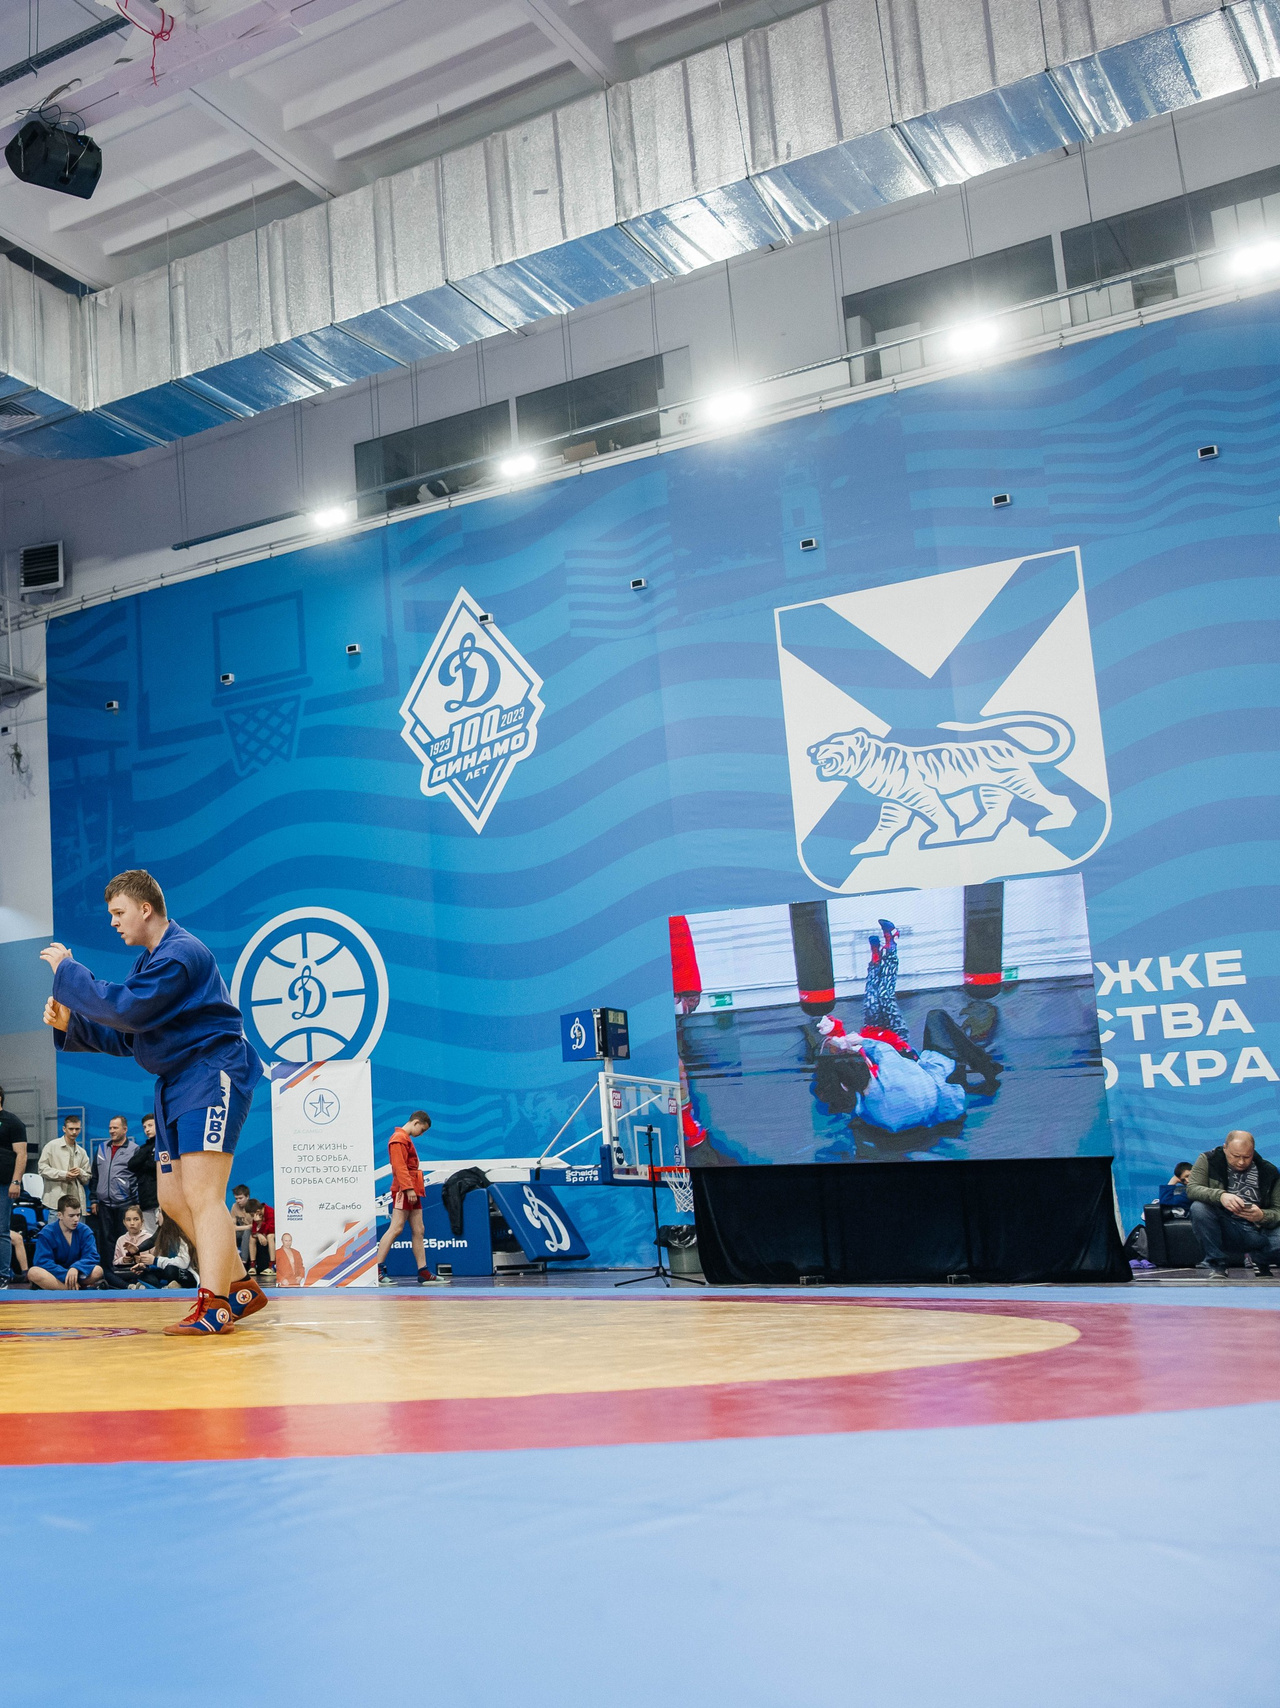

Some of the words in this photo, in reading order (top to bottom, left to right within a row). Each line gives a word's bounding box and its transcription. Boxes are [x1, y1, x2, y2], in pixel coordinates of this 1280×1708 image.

[500, 706, 525, 728] 2023
[436, 707, 523, 763] 100
[429, 737, 451, 758] 1923
[430, 731, 526, 784] ДИНАМО
[464, 764, 490, 782] ЛЕТ
[1093, 949, 1247, 996] ЖКЕ
[1139, 1046, 1280, 1089] КРА
[292, 1143, 315, 1151] ЕСЛИ
[316, 1143, 348, 1151] ЖИЗНЬ
[315, 1154, 351, 1162] БОРЬБА,
[280, 1166, 292, 1174] ТО
[293, 1166, 321, 1174] ПУСТЬ
[322, 1165, 340, 1173] ЭТО
[341, 1164, 368, 1173] БУДЕТ
[290, 1177, 324, 1185] БОРЬБА
[324, 1176, 359, 1185] САМБО!
[565, 1176, 599, 1184] Sports
